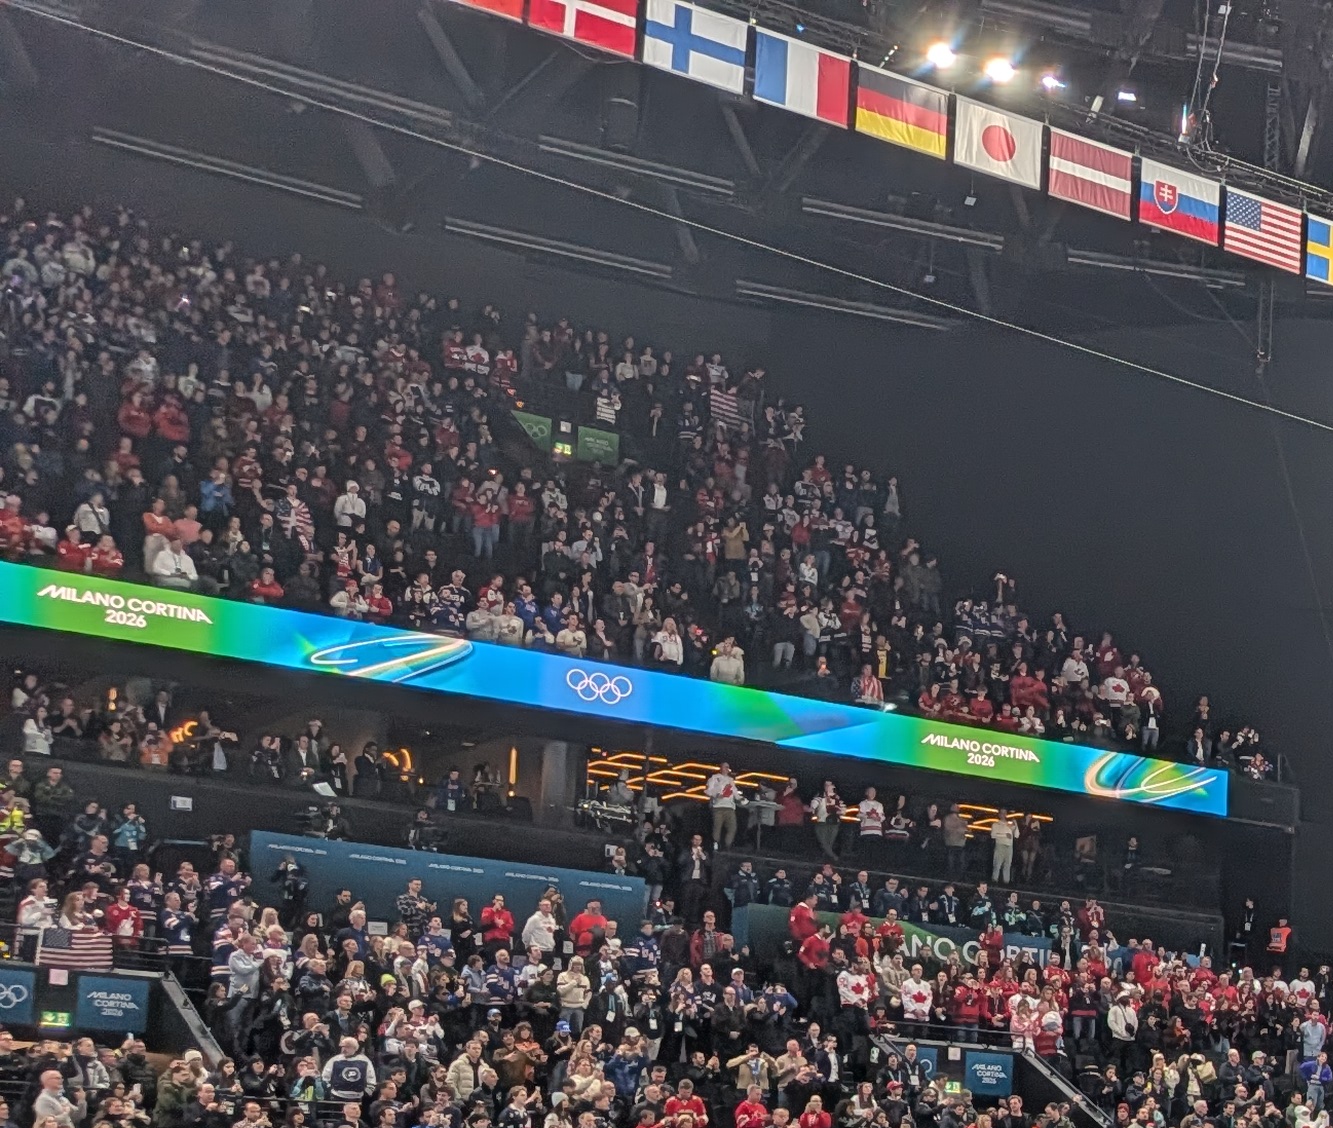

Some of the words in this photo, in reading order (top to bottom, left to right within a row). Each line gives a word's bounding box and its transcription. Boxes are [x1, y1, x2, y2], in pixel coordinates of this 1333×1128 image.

[36, 584, 125, 609] MILANO
[127, 597, 214, 625] CORTINA
[104, 609, 148, 628] 2026
[921, 733, 981, 752] MILANO
[982, 742, 1041, 763] CORTINA
[967, 752, 996, 767] 2026
[86, 991, 132, 1001] MILANO
